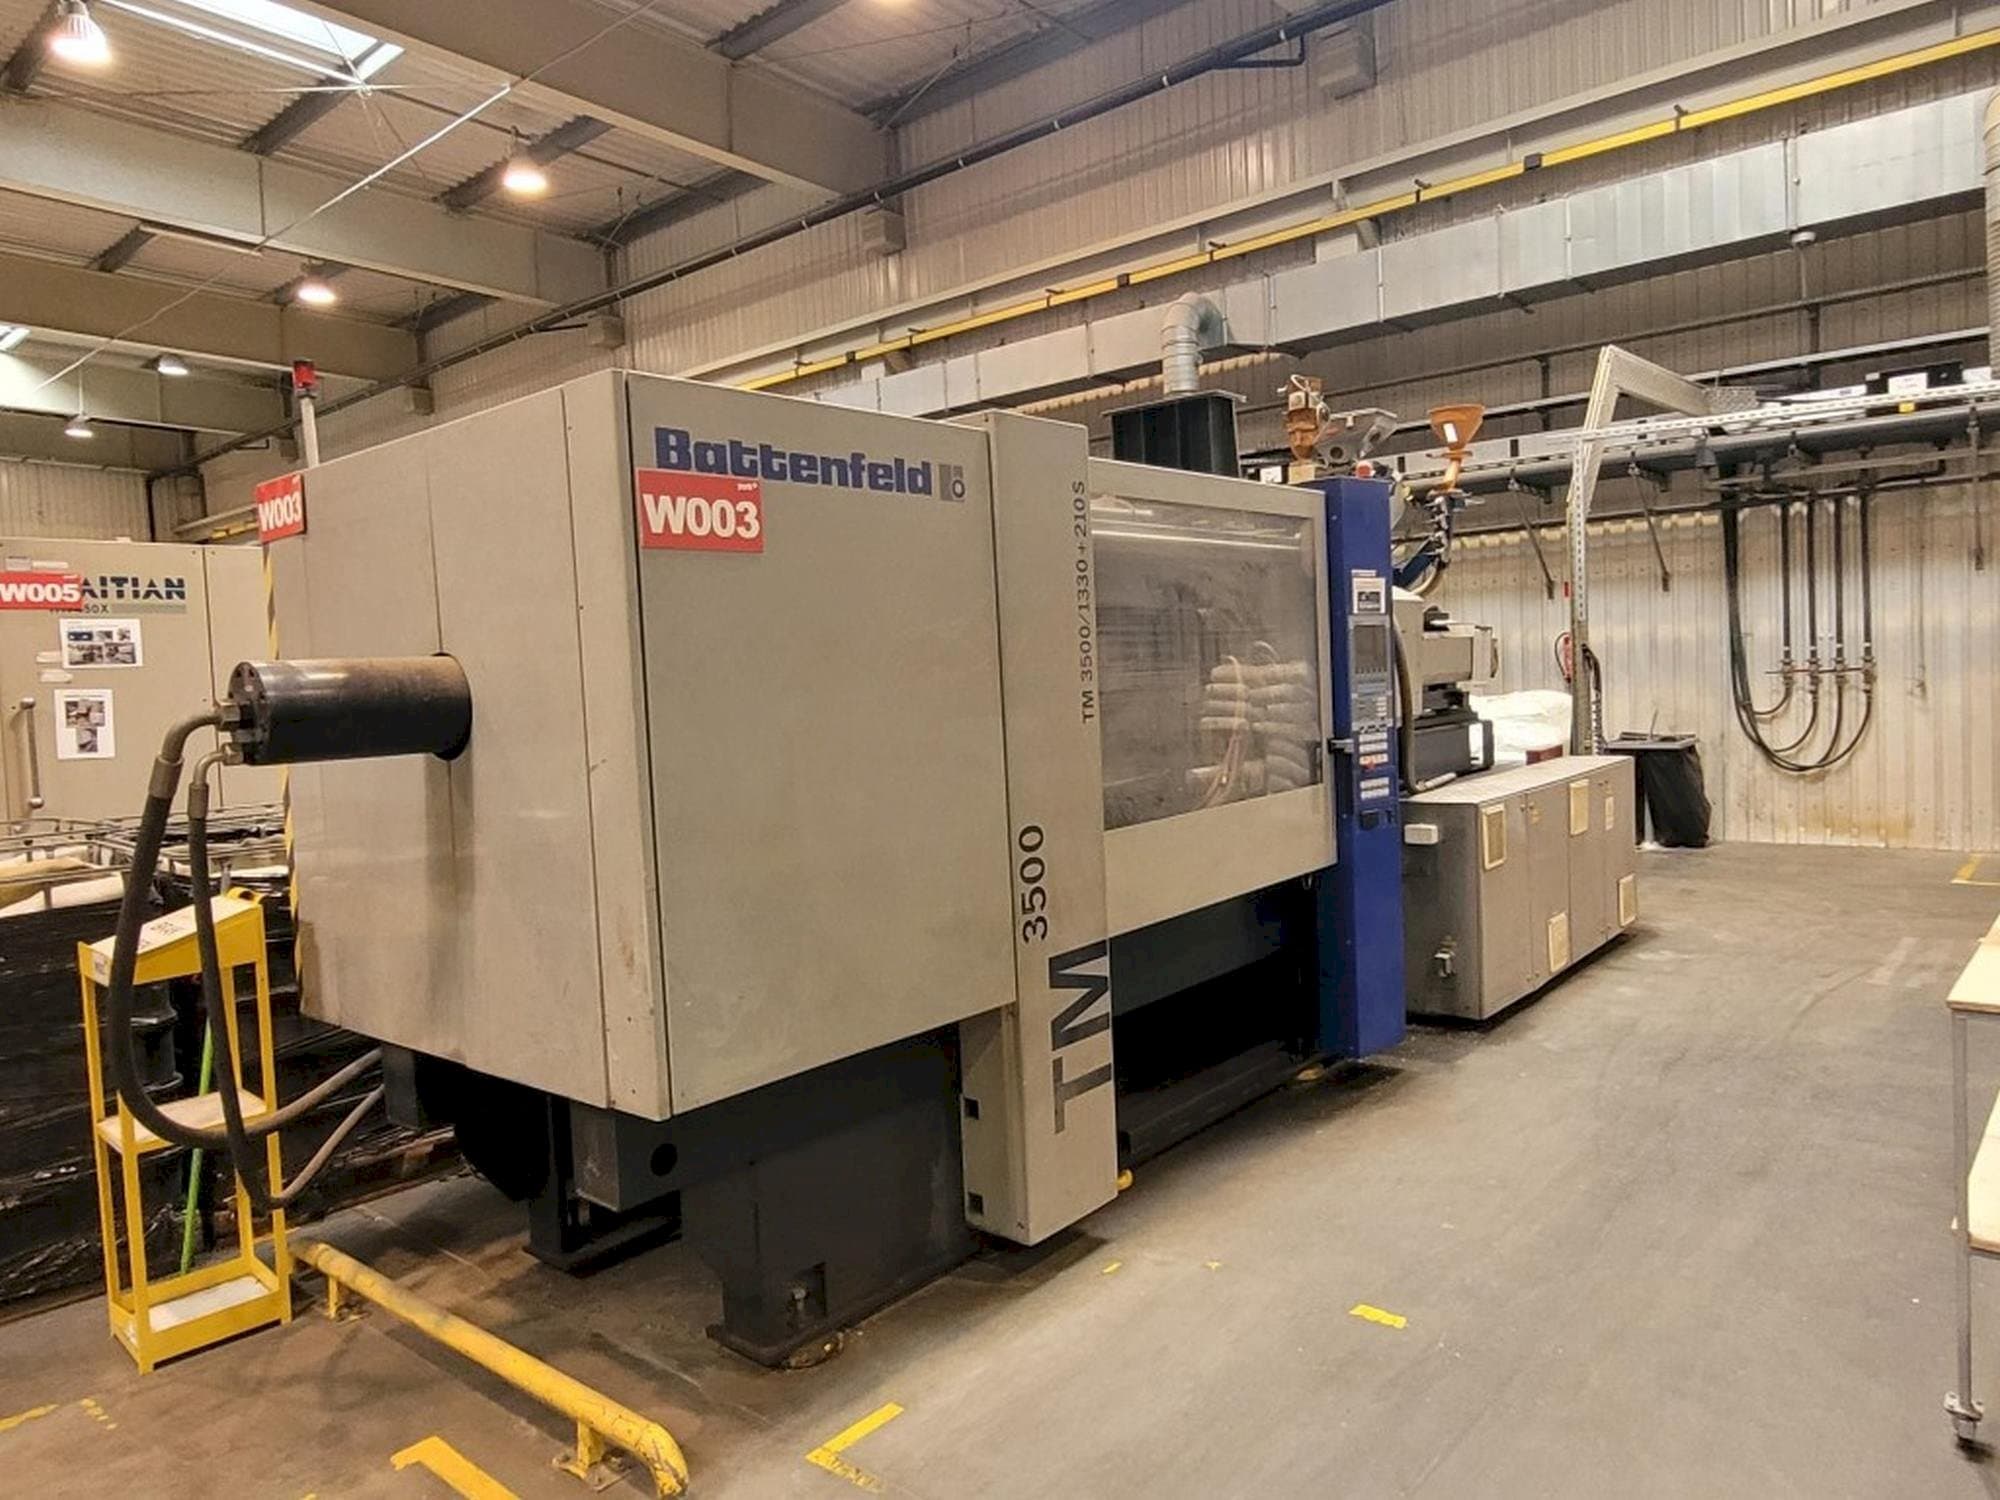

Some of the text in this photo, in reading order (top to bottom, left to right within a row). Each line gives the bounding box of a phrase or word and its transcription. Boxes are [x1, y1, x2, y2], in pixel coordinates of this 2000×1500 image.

[654, 426, 933, 496] Battenfeld
[258, 490, 302, 532] W003
[642, 493, 761, 540] W003
[0, 583, 81, 602] W005
[81, 576, 186, 600] AITIAN
[1081, 689, 1095, 724] TM
[1018, 825, 1049, 944] 3500
[1048, 939, 1112, 1135] TM
